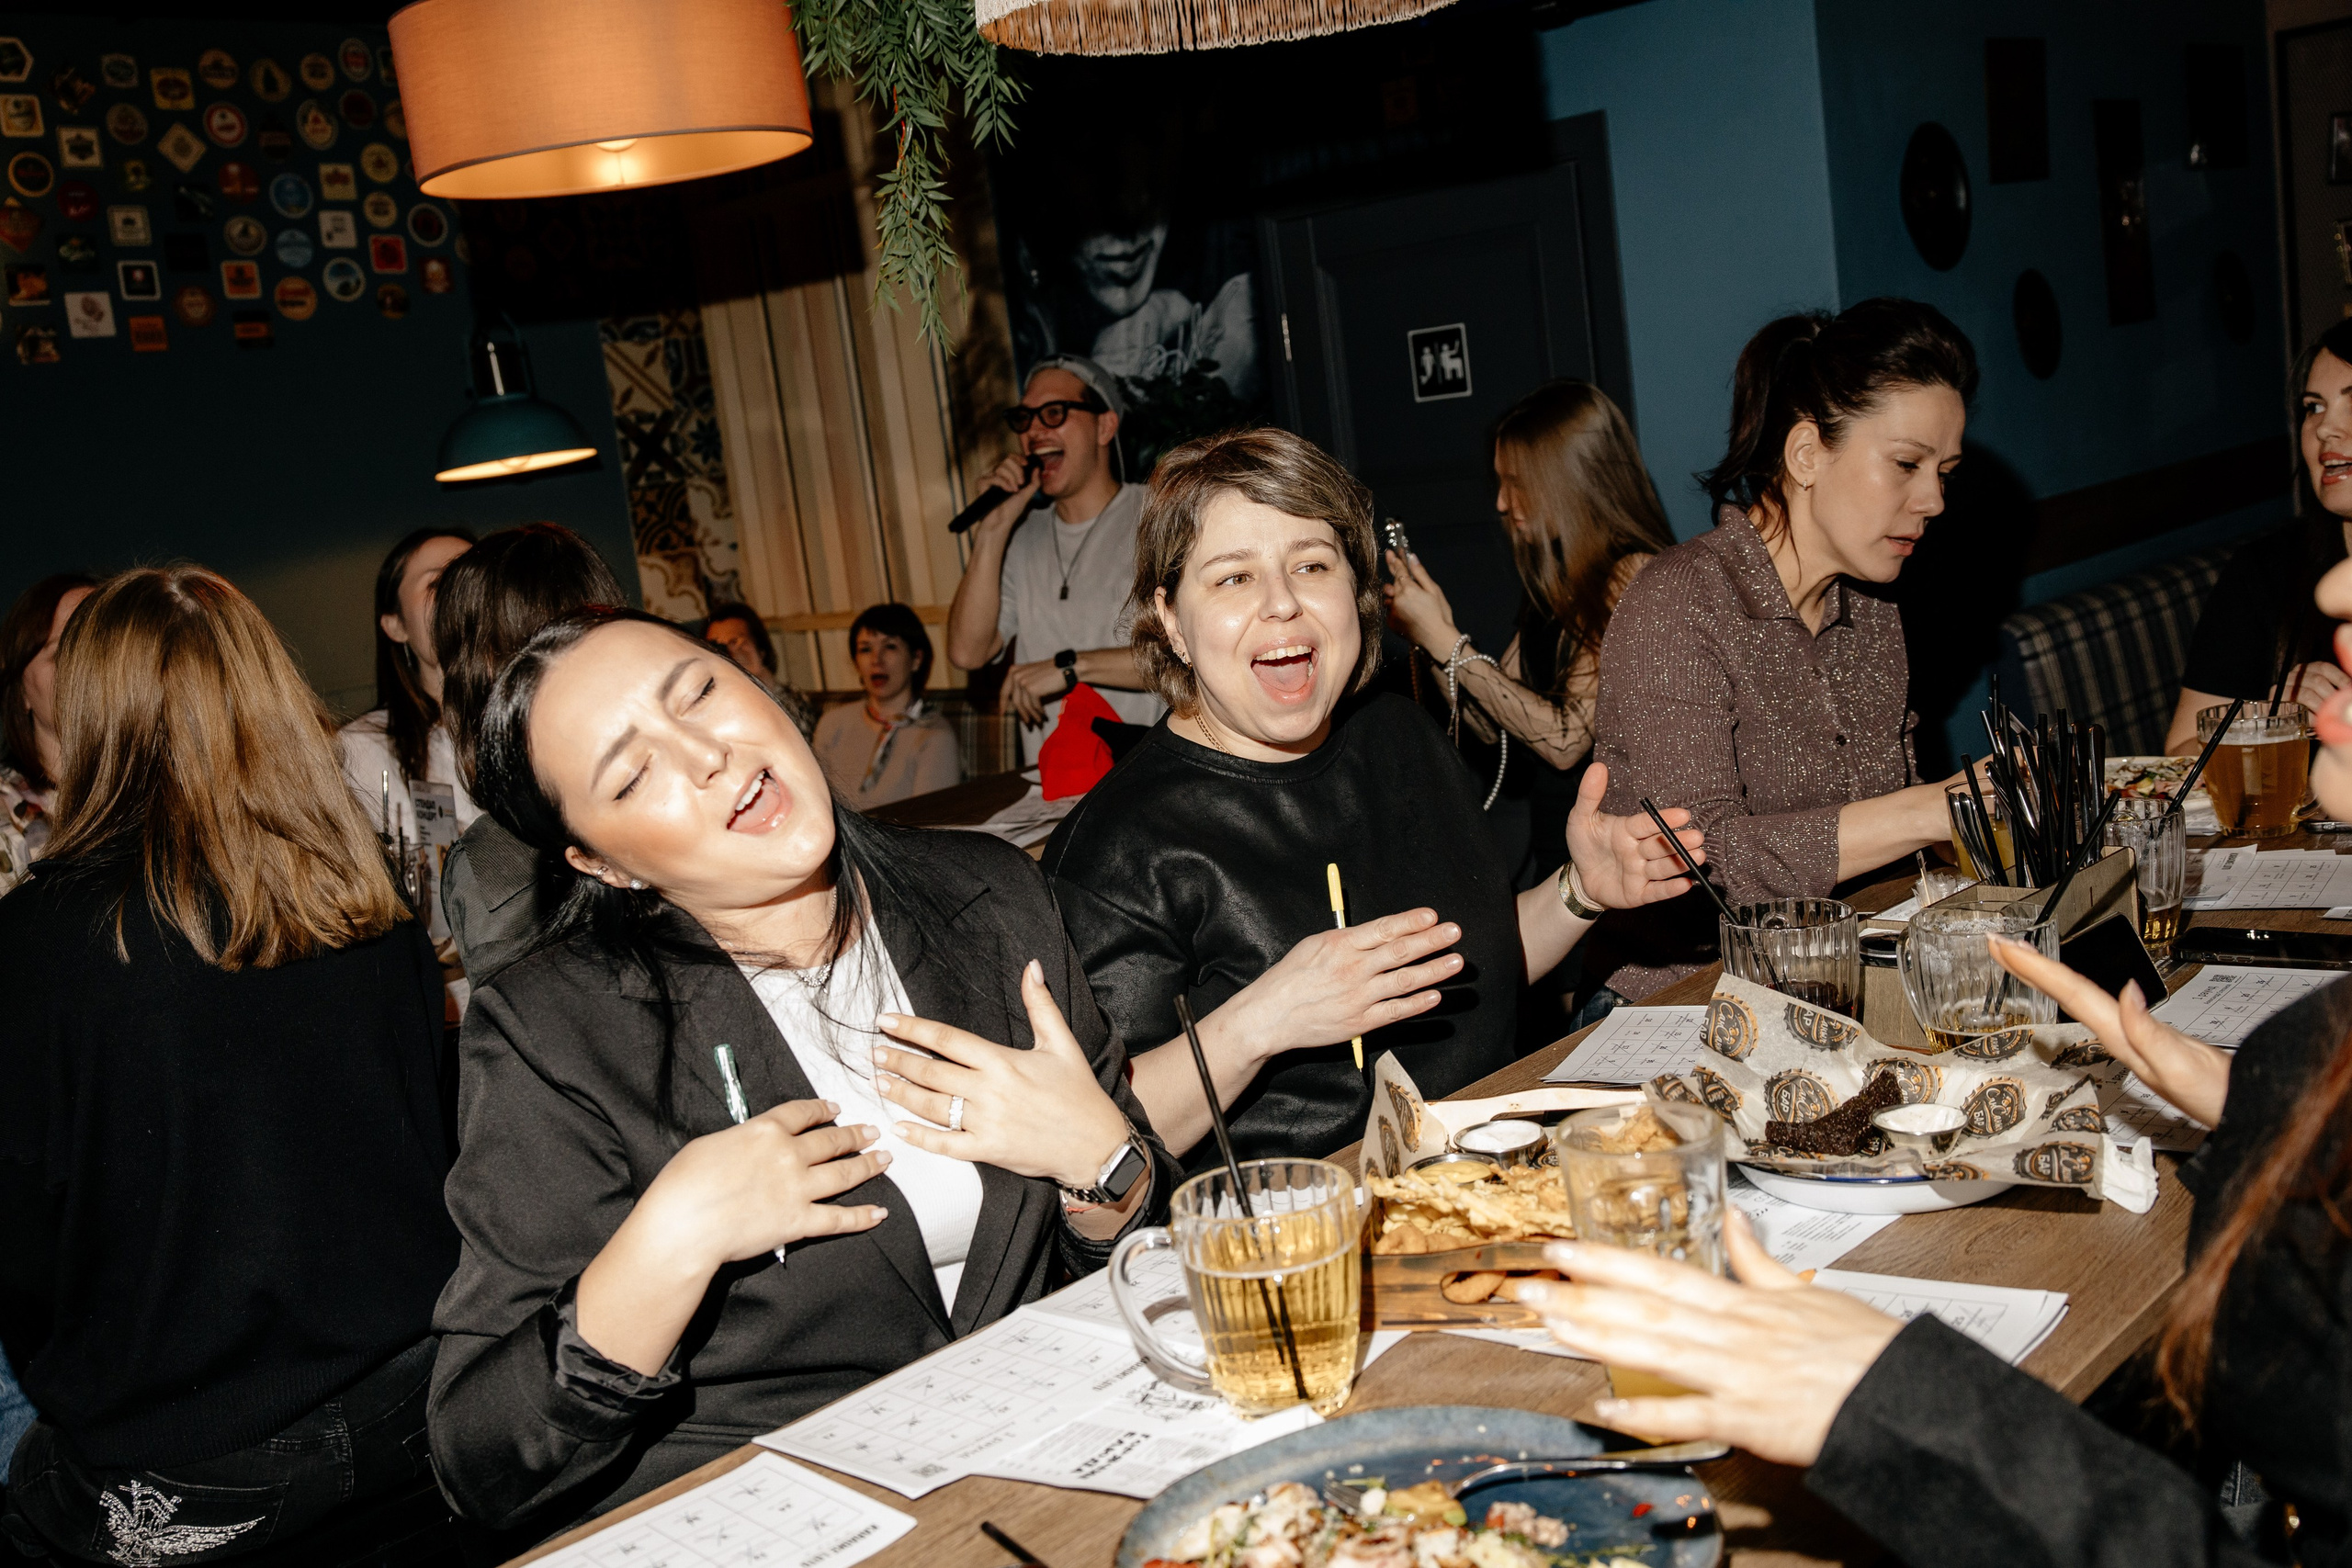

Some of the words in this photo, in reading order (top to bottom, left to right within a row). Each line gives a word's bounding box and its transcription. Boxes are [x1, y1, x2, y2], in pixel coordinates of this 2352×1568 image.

[1781, 1085, 1792, 1113] БАР
[1973, 1109, 1986, 1127] БАР
[2037, 1154, 2052, 1176] БАР
